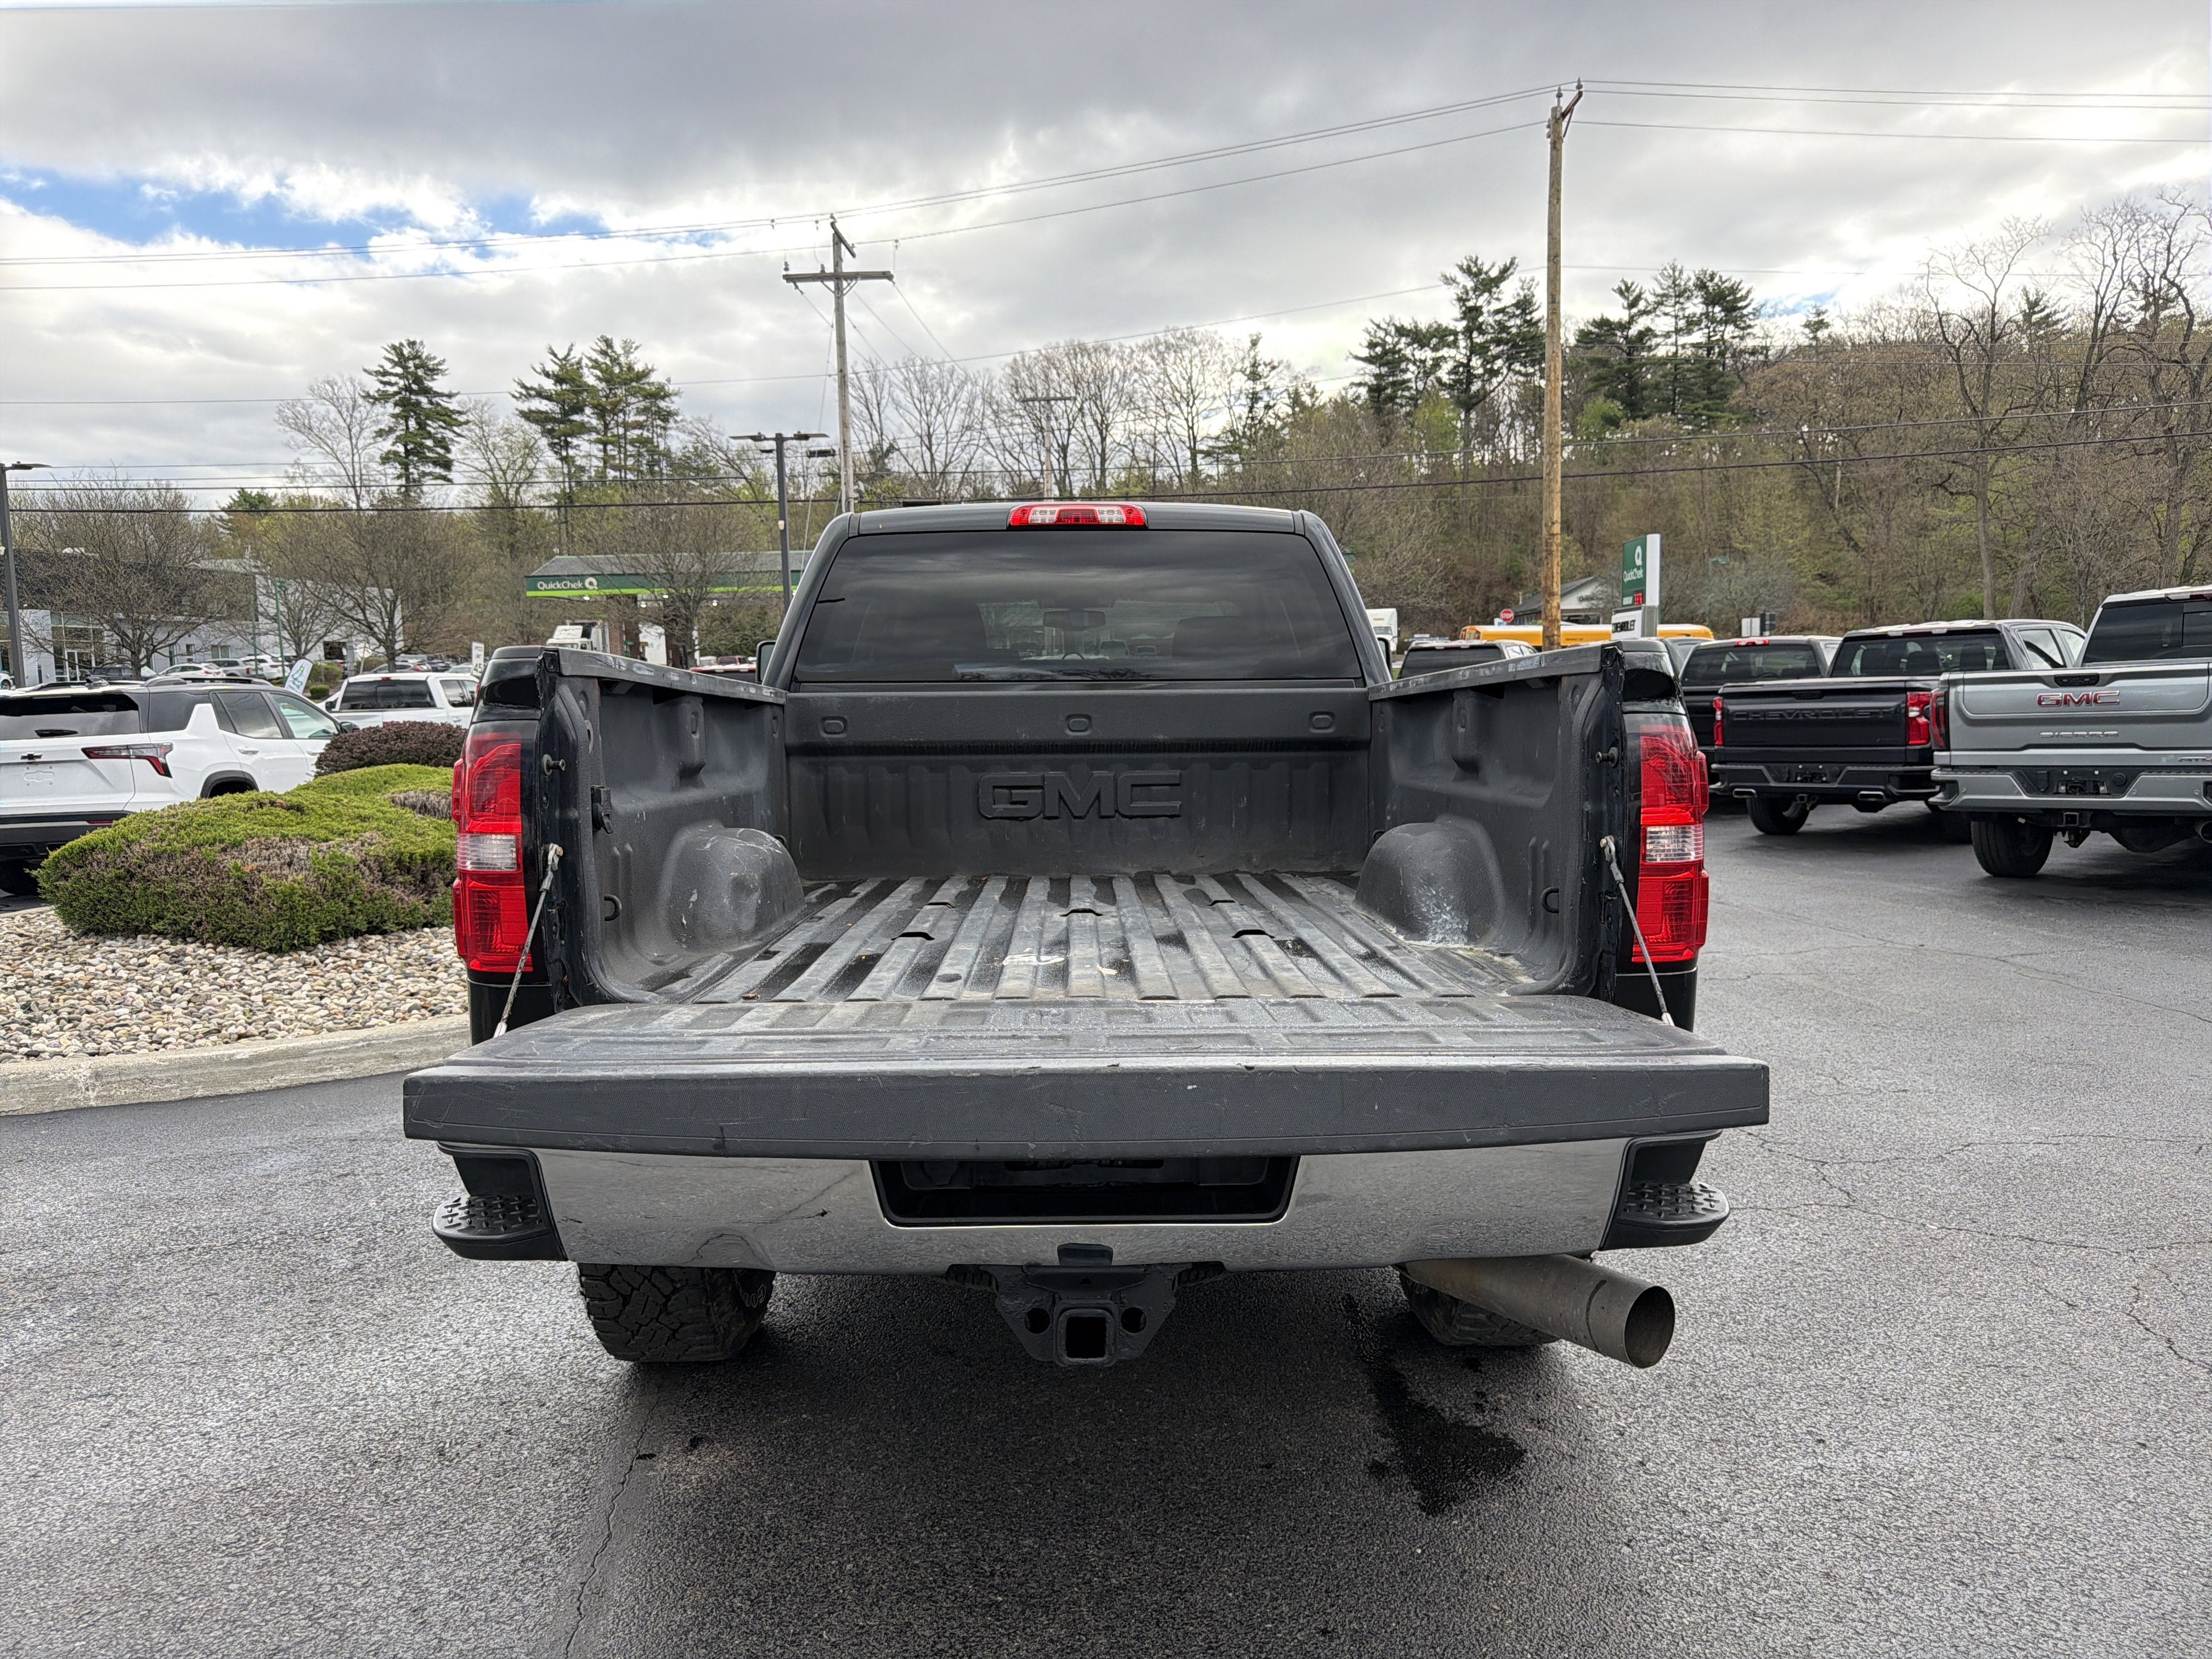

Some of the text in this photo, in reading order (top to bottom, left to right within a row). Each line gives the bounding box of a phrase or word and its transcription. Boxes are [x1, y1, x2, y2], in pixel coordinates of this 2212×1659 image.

[1623, 566, 1643, 583] QuickChek
[537, 580, 583, 590] QuickChek
[474, 663, 483, 673] 45
[2037, 690, 2120, 707] GMC
[1733, 708, 1892, 720] CHEVROLET
[977, 770, 1182, 821] GMC
